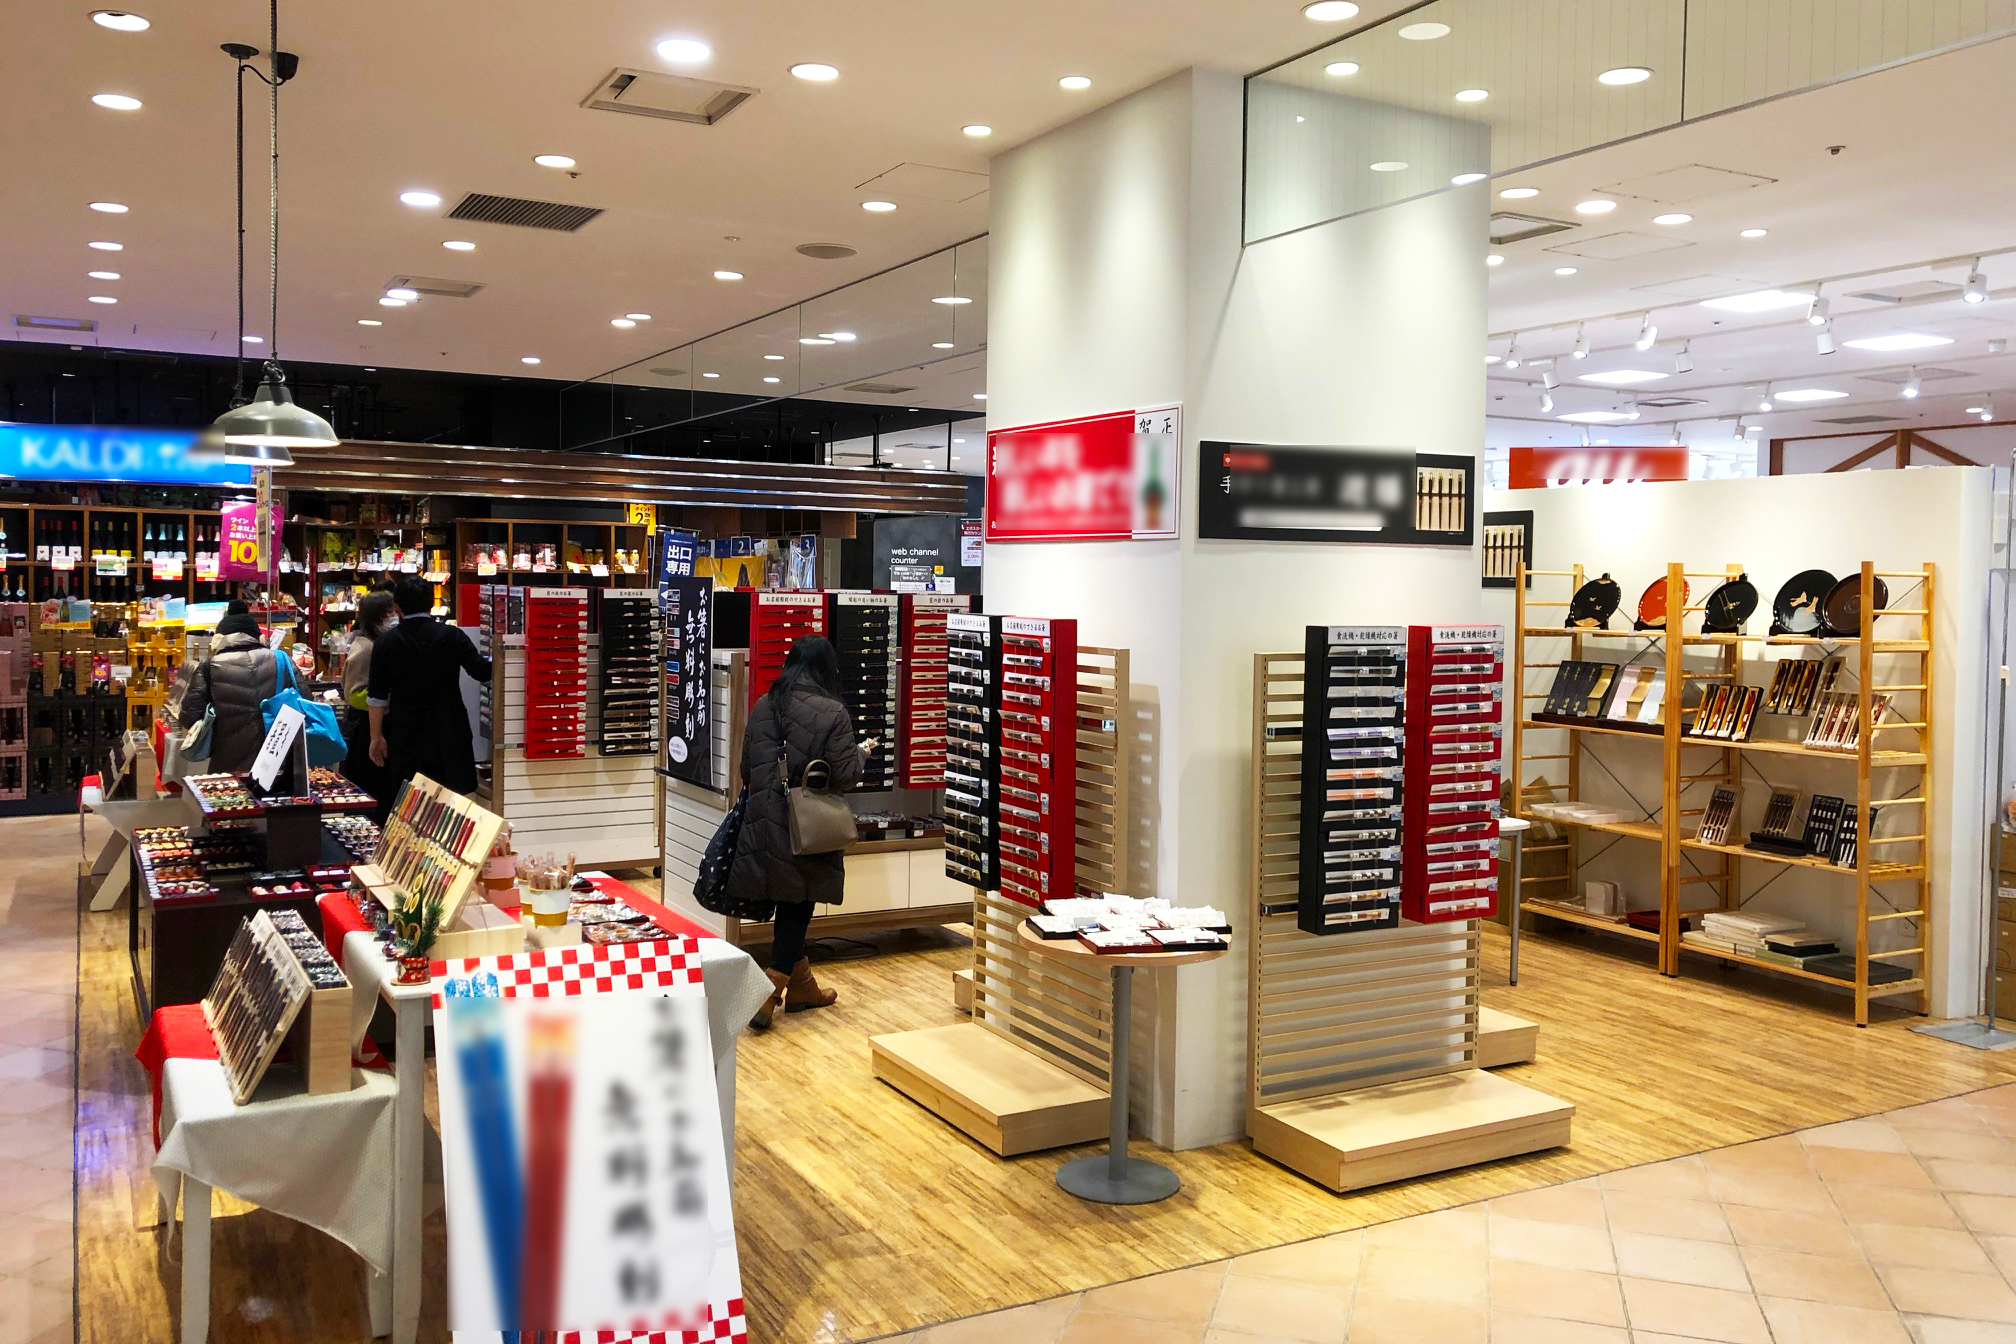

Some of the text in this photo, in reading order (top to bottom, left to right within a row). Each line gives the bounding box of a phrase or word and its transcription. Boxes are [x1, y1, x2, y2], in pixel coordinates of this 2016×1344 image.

[738, 540, 745, 554] 2
[804, 539, 811, 550] 3
[667, 545, 693, 561] 出口
[891, 547, 939, 556] web channel
[890, 557, 919, 565] counter
[665, 560, 691, 576] 専用
[1336, 630, 1399, 641] 食洗機・乾燥機対応の箸
[1439, 629, 1498, 640] 食洗機・乾燥機対応の箸
[695, 586, 708, 728] お箸にお名前
[684, 609, 696, 741] 無料彫刻
